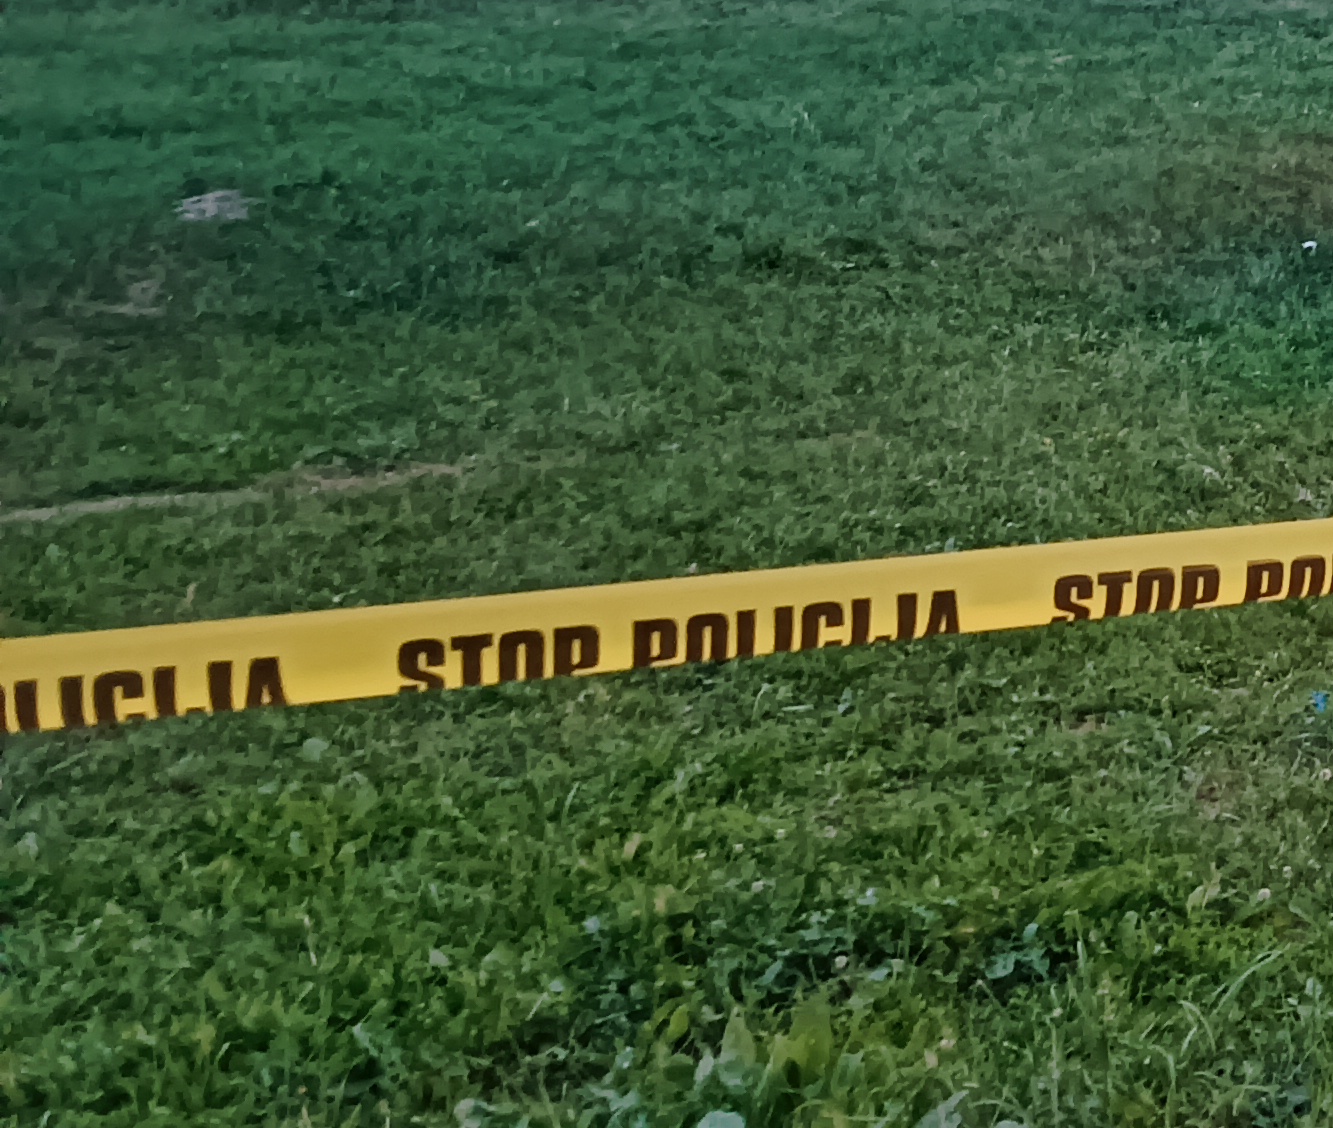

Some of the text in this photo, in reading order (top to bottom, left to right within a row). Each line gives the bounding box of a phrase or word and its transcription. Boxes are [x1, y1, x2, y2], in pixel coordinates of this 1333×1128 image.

[1050, 563, 1221, 623] STOP
[398, 589, 961, 692] STOP POLICIJA
[0, 657, 290, 733] LICIJA
